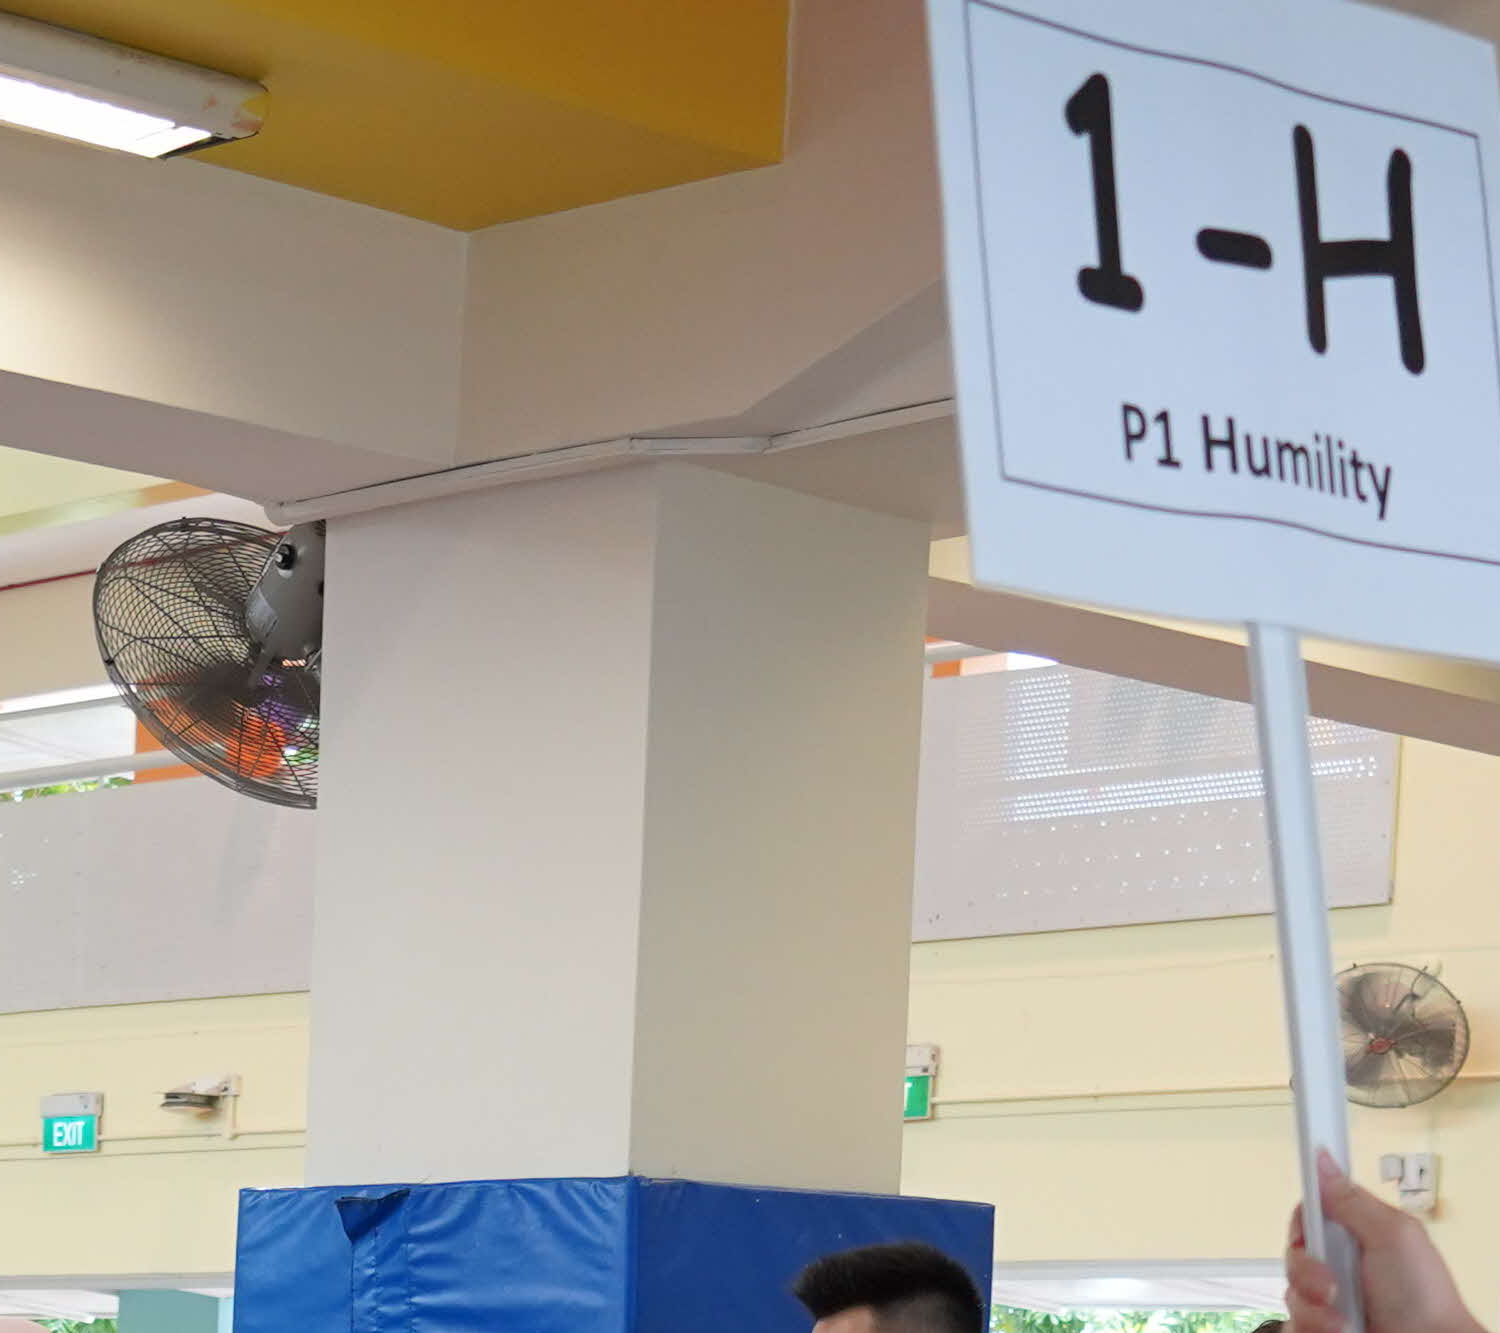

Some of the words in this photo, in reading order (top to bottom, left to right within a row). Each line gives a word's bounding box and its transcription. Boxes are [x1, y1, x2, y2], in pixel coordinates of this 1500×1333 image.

[1065, 72, 1425, 375] 1-H
[1120, 402, 1183, 470] P1
[1202, 414, 1393, 521] Humility
[53, 1121, 86, 1147] EXIT
